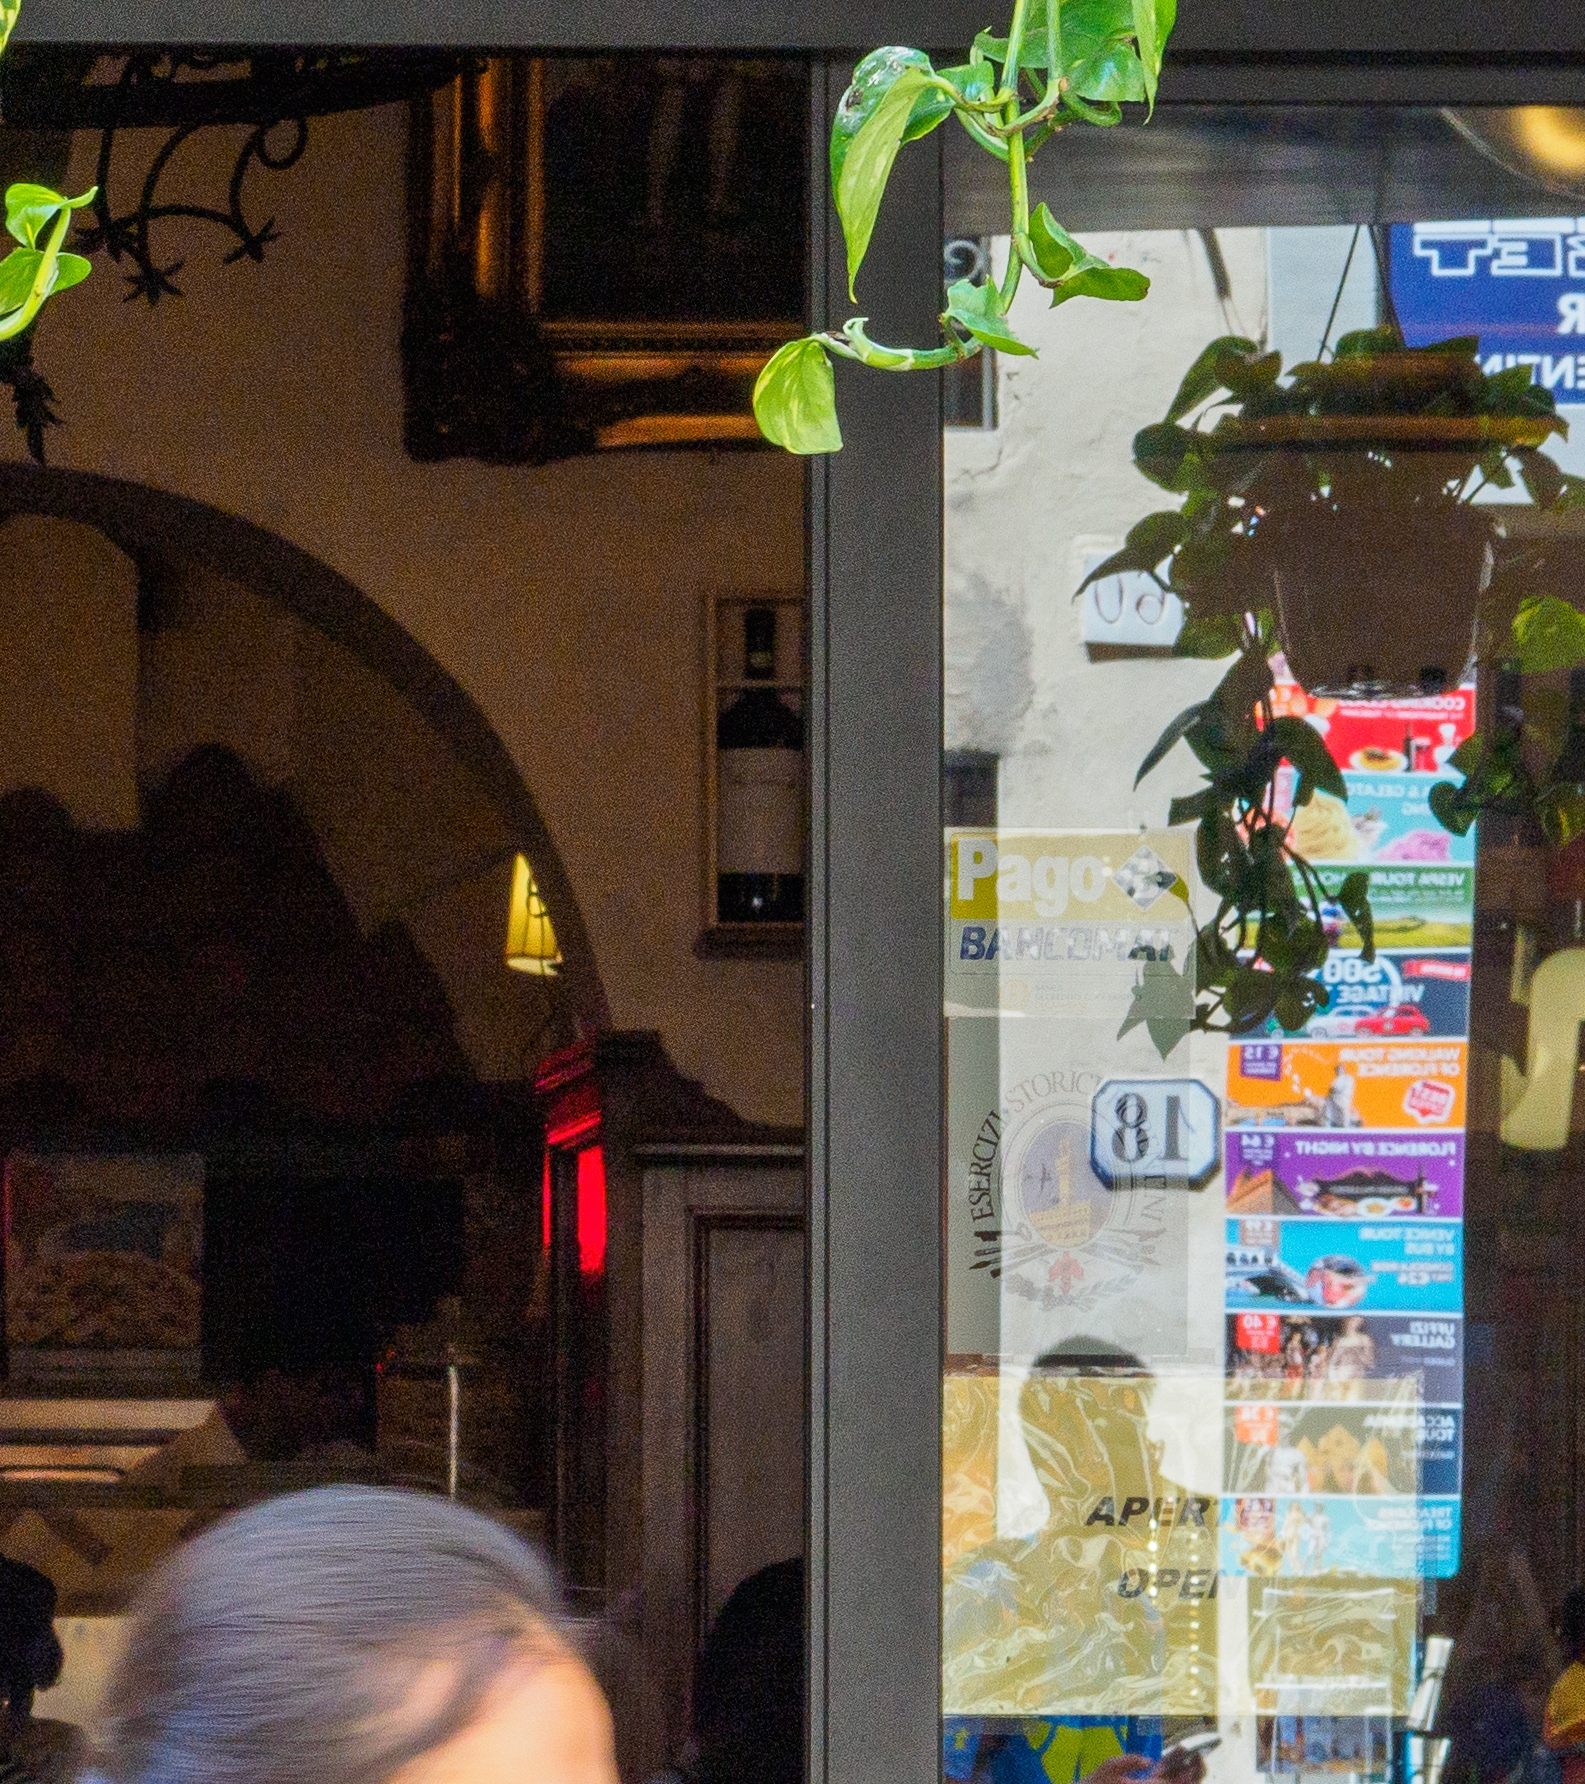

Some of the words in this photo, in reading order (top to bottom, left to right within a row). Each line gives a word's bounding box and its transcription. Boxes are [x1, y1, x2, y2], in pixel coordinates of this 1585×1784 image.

[958, 837, 1107, 918] Pago
[959, 925, 1173, 962] BANCOMAT
[1086, 1496, 1221, 1526] APER
